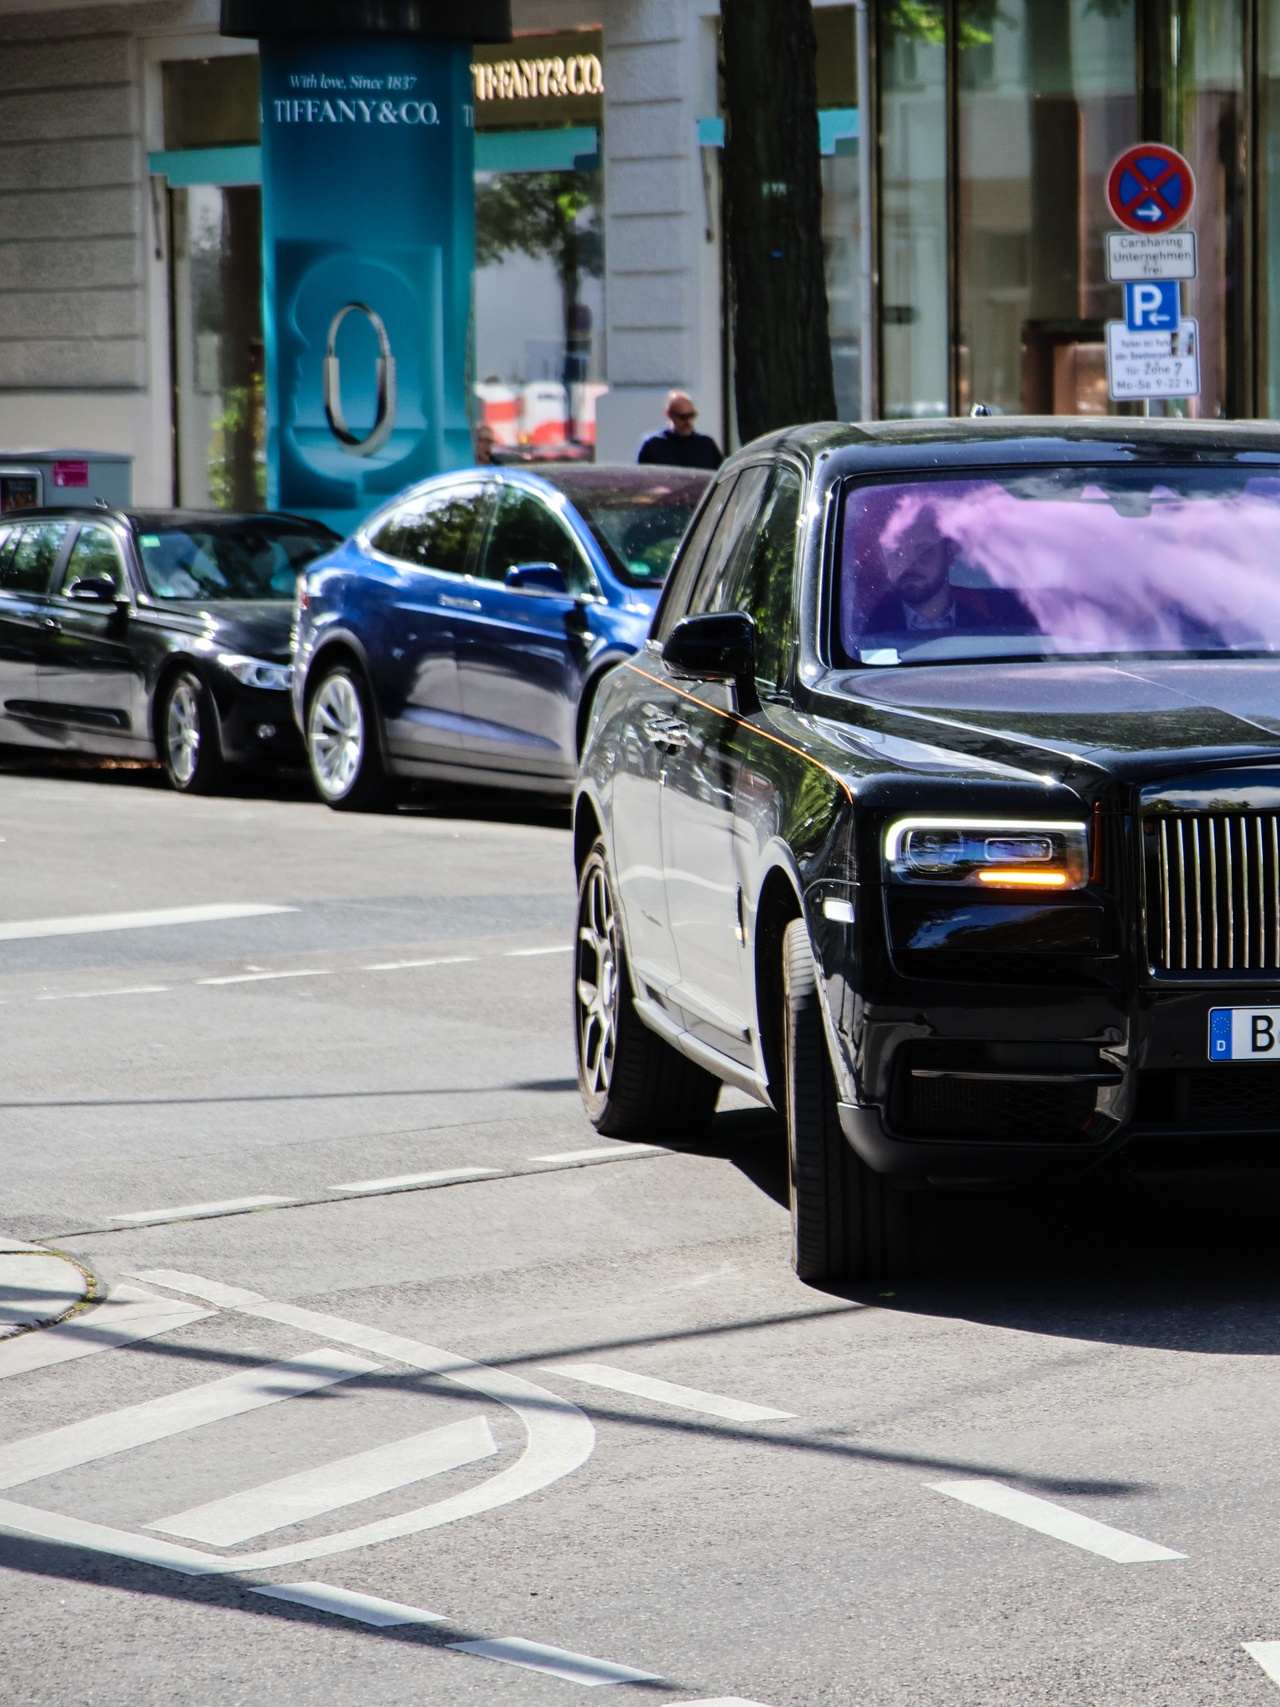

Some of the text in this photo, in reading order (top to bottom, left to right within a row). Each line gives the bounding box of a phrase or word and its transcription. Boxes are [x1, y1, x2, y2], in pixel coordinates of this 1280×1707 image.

[289, 73, 418, 91] With love, Since 1837
[469, 53, 604, 101] IFFANY&CO.
[274, 99, 440, 125] TIFFANY&CO.
[1120, 237, 1183, 249] Carsharing
[1113, 251, 1191, 262] Unternehmen
[1143, 265, 1163, 275] frei
[1133, 283, 1163, 326] P
[1126, 364, 1139, 375] für
[1144, 363, 1171, 375] Zone
[1251, 1015, 1275, 1053] B
[1216, 1040, 1226, 1051] D
